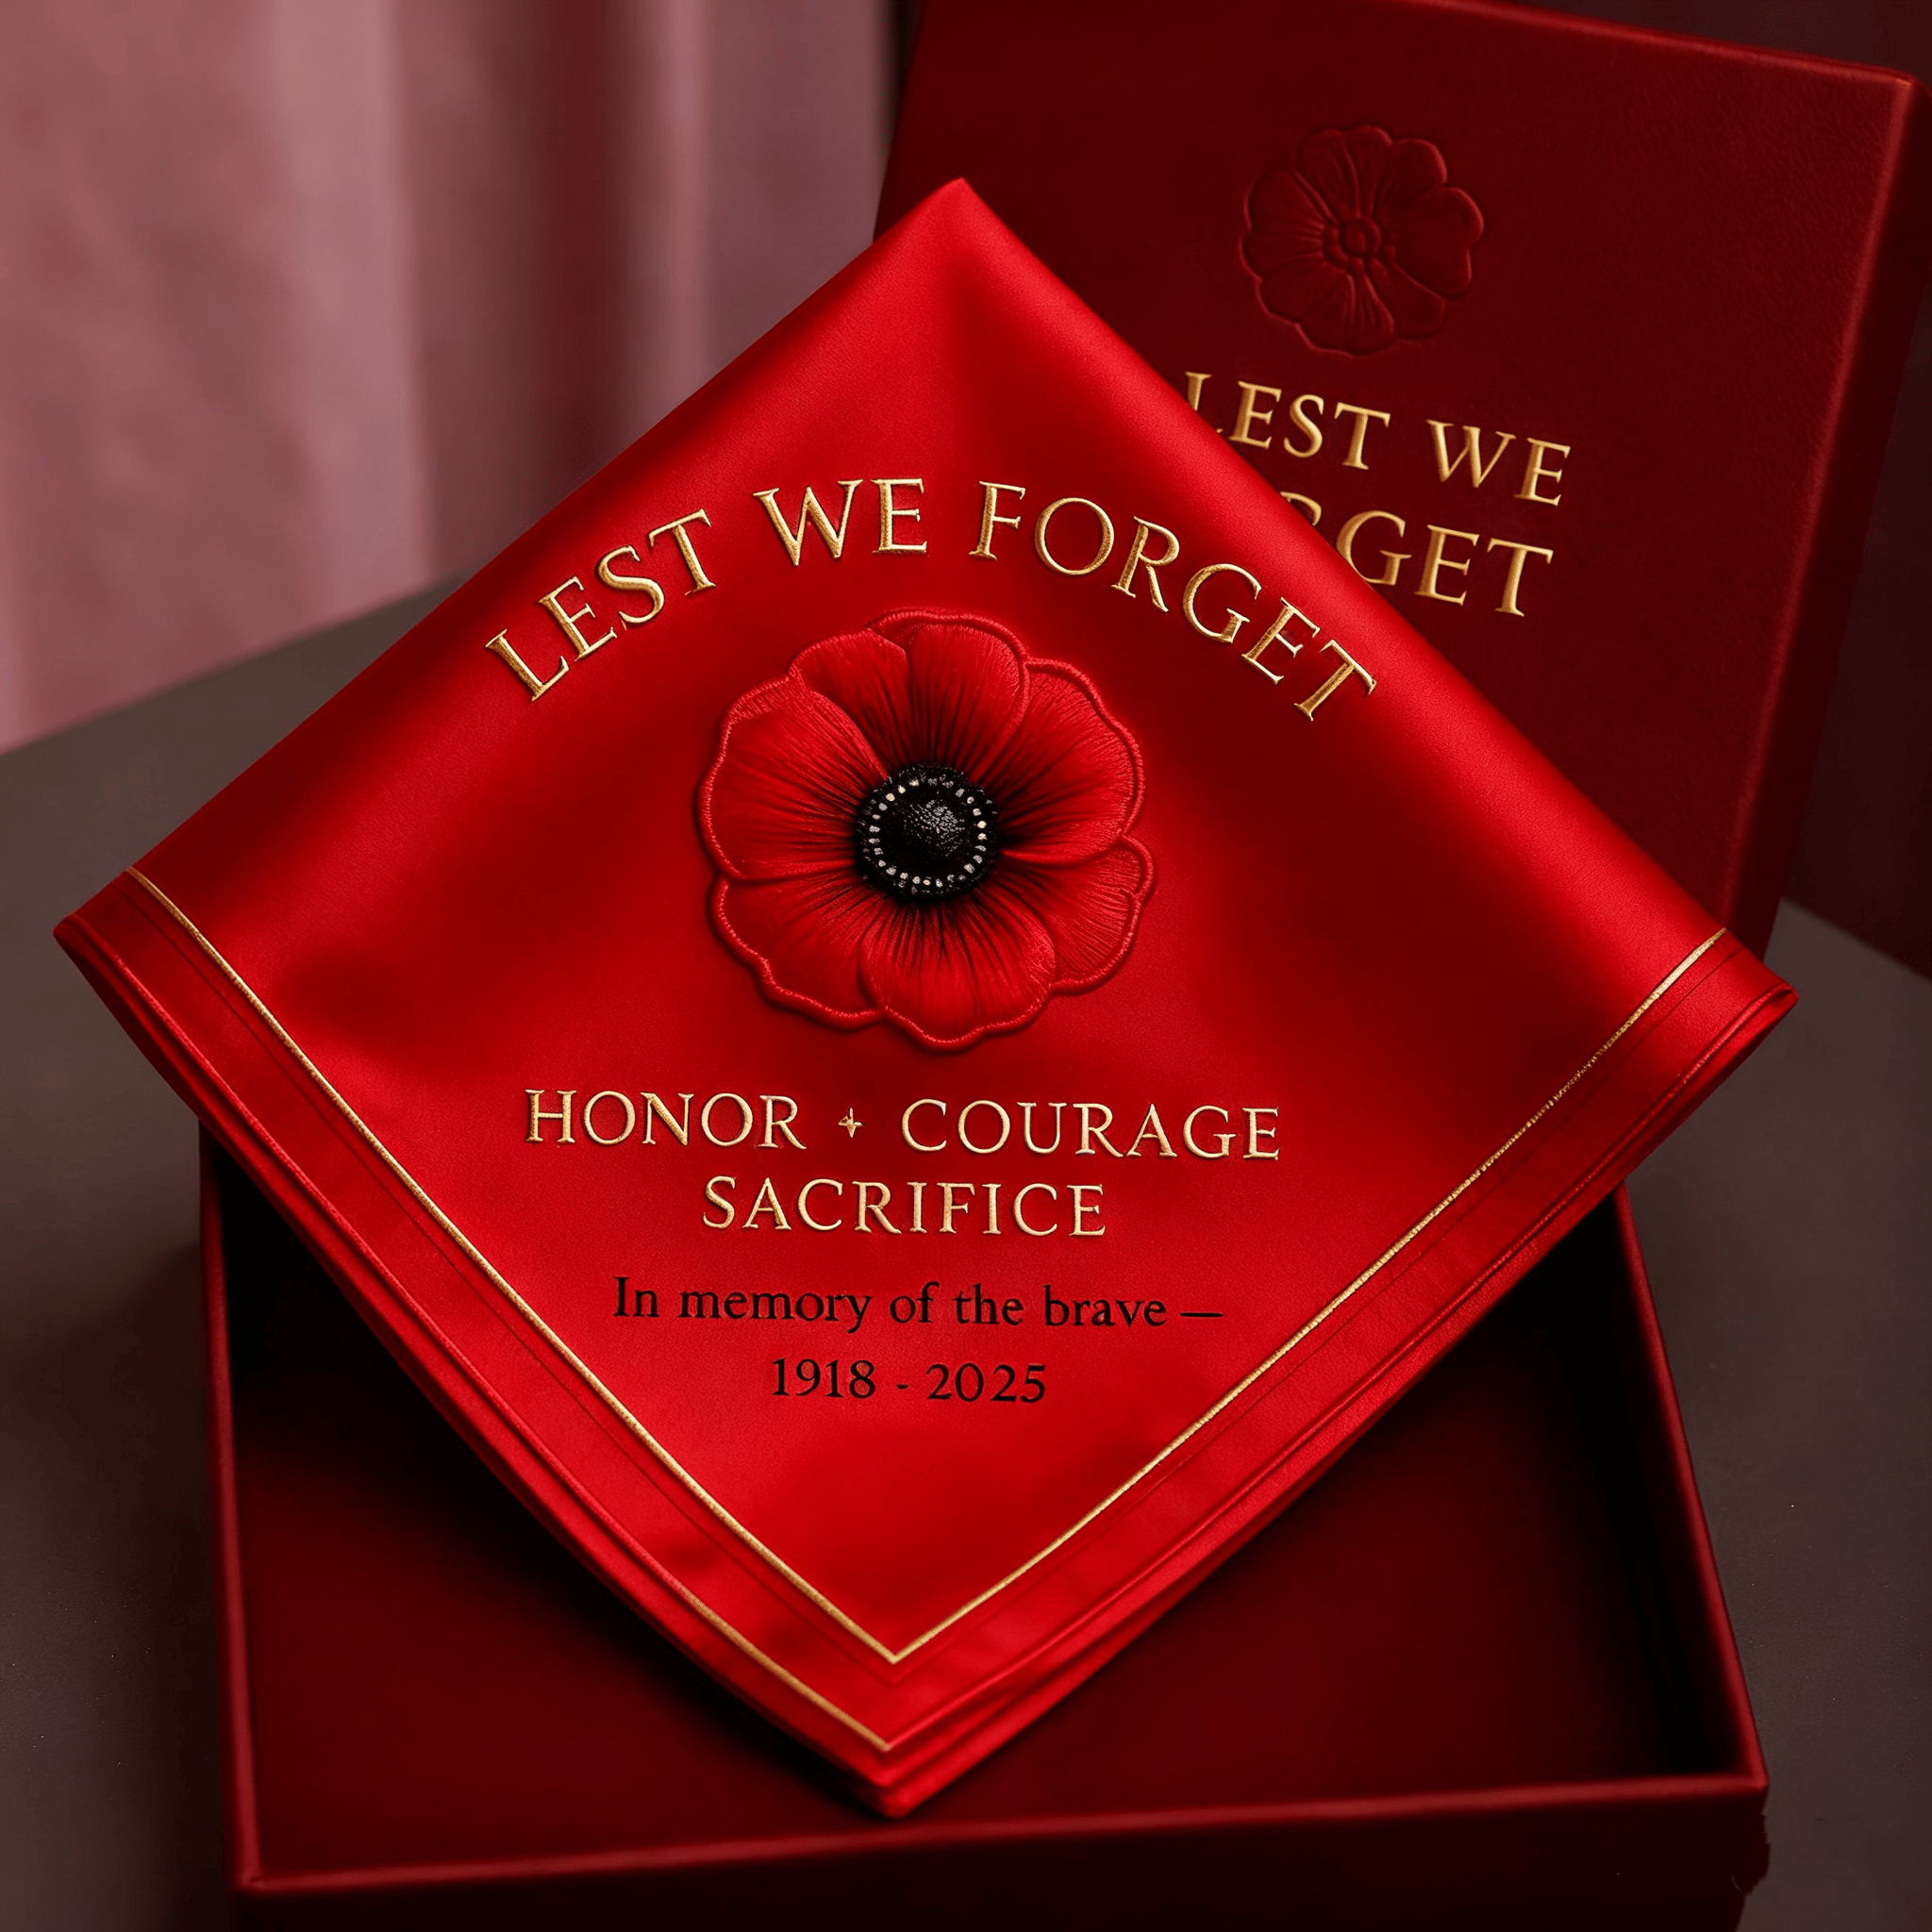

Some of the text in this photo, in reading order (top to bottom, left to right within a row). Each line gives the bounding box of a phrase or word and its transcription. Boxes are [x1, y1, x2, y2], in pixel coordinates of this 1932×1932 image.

[1425, 419, 1571, 507] WE
[484, 476, 1377, 723] LEST WE FORGET
[525, 1089, 1280, 1161] HONOR COURAGE
[702, 1175, 1107, 1238] SACRIFICE
[613, 1276, 659, 1318] In
[678, 1291, 874, 1335] memory
[890, 1281, 941, 1324] of
[953, 1283, 1024, 1325] the
[1042, 1284, 1167, 1327] brave
[772, 1357, 875, 1399] 1918
[925, 1362, 1046, 1404] 2025
